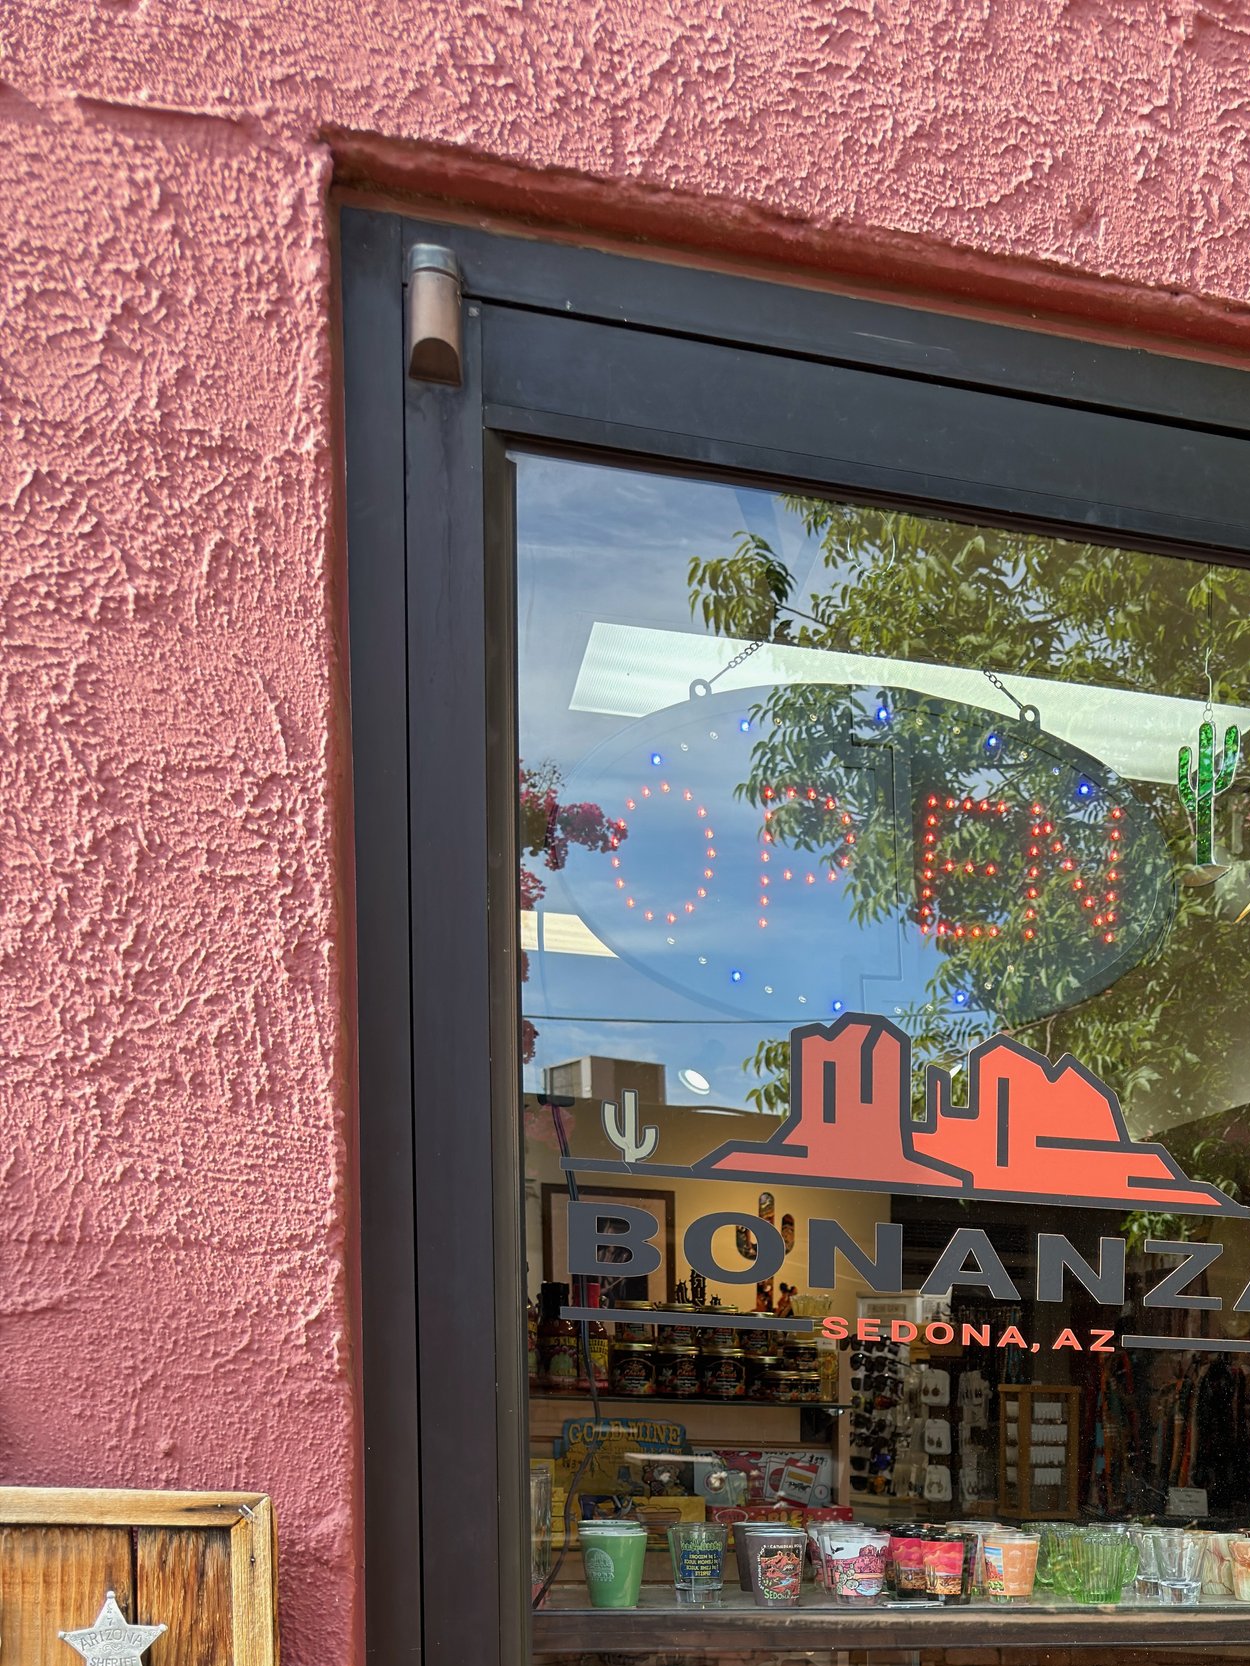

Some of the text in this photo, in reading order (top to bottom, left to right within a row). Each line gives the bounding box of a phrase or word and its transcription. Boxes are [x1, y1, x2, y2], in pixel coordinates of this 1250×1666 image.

[612, 782, 1122, 943] OPEN
[822, 1316, 1115, 1355] SEDONA, AZ
[568, 1422, 682, 1445] GOLD MINE
[79, 1629, 144, 1652] ARIZONA
